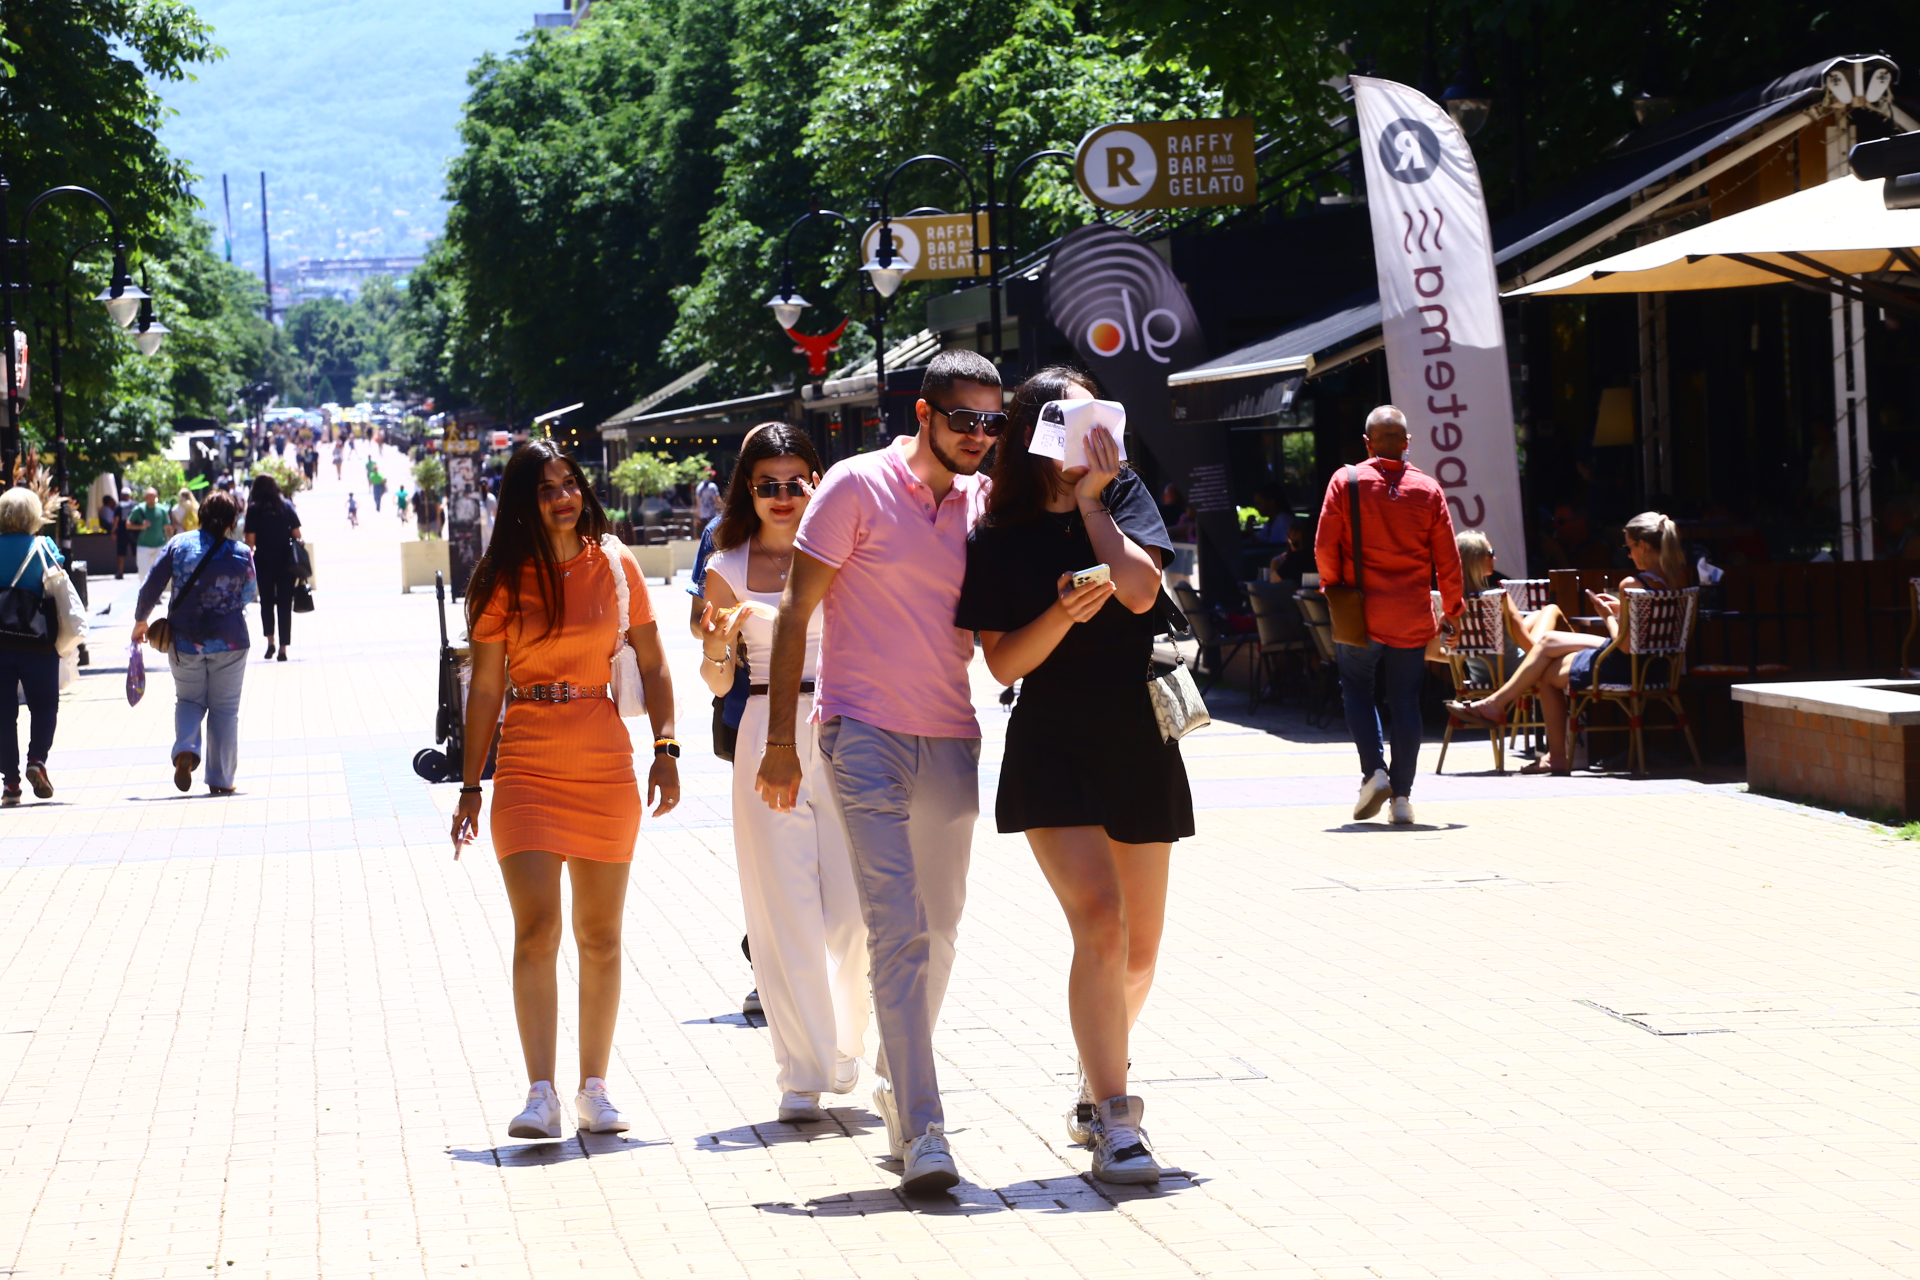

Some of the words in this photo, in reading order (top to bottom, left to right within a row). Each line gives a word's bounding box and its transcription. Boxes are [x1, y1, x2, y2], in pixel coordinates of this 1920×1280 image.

[1167, 133, 1233, 154] RAFFY
[1106, 147, 1141, 188] R
[1168, 156, 1207, 175] BAR
[1211, 154, 1234, 165] AND
[1169, 175, 1244, 196] GELATO
[927, 240, 956, 256] BAR
